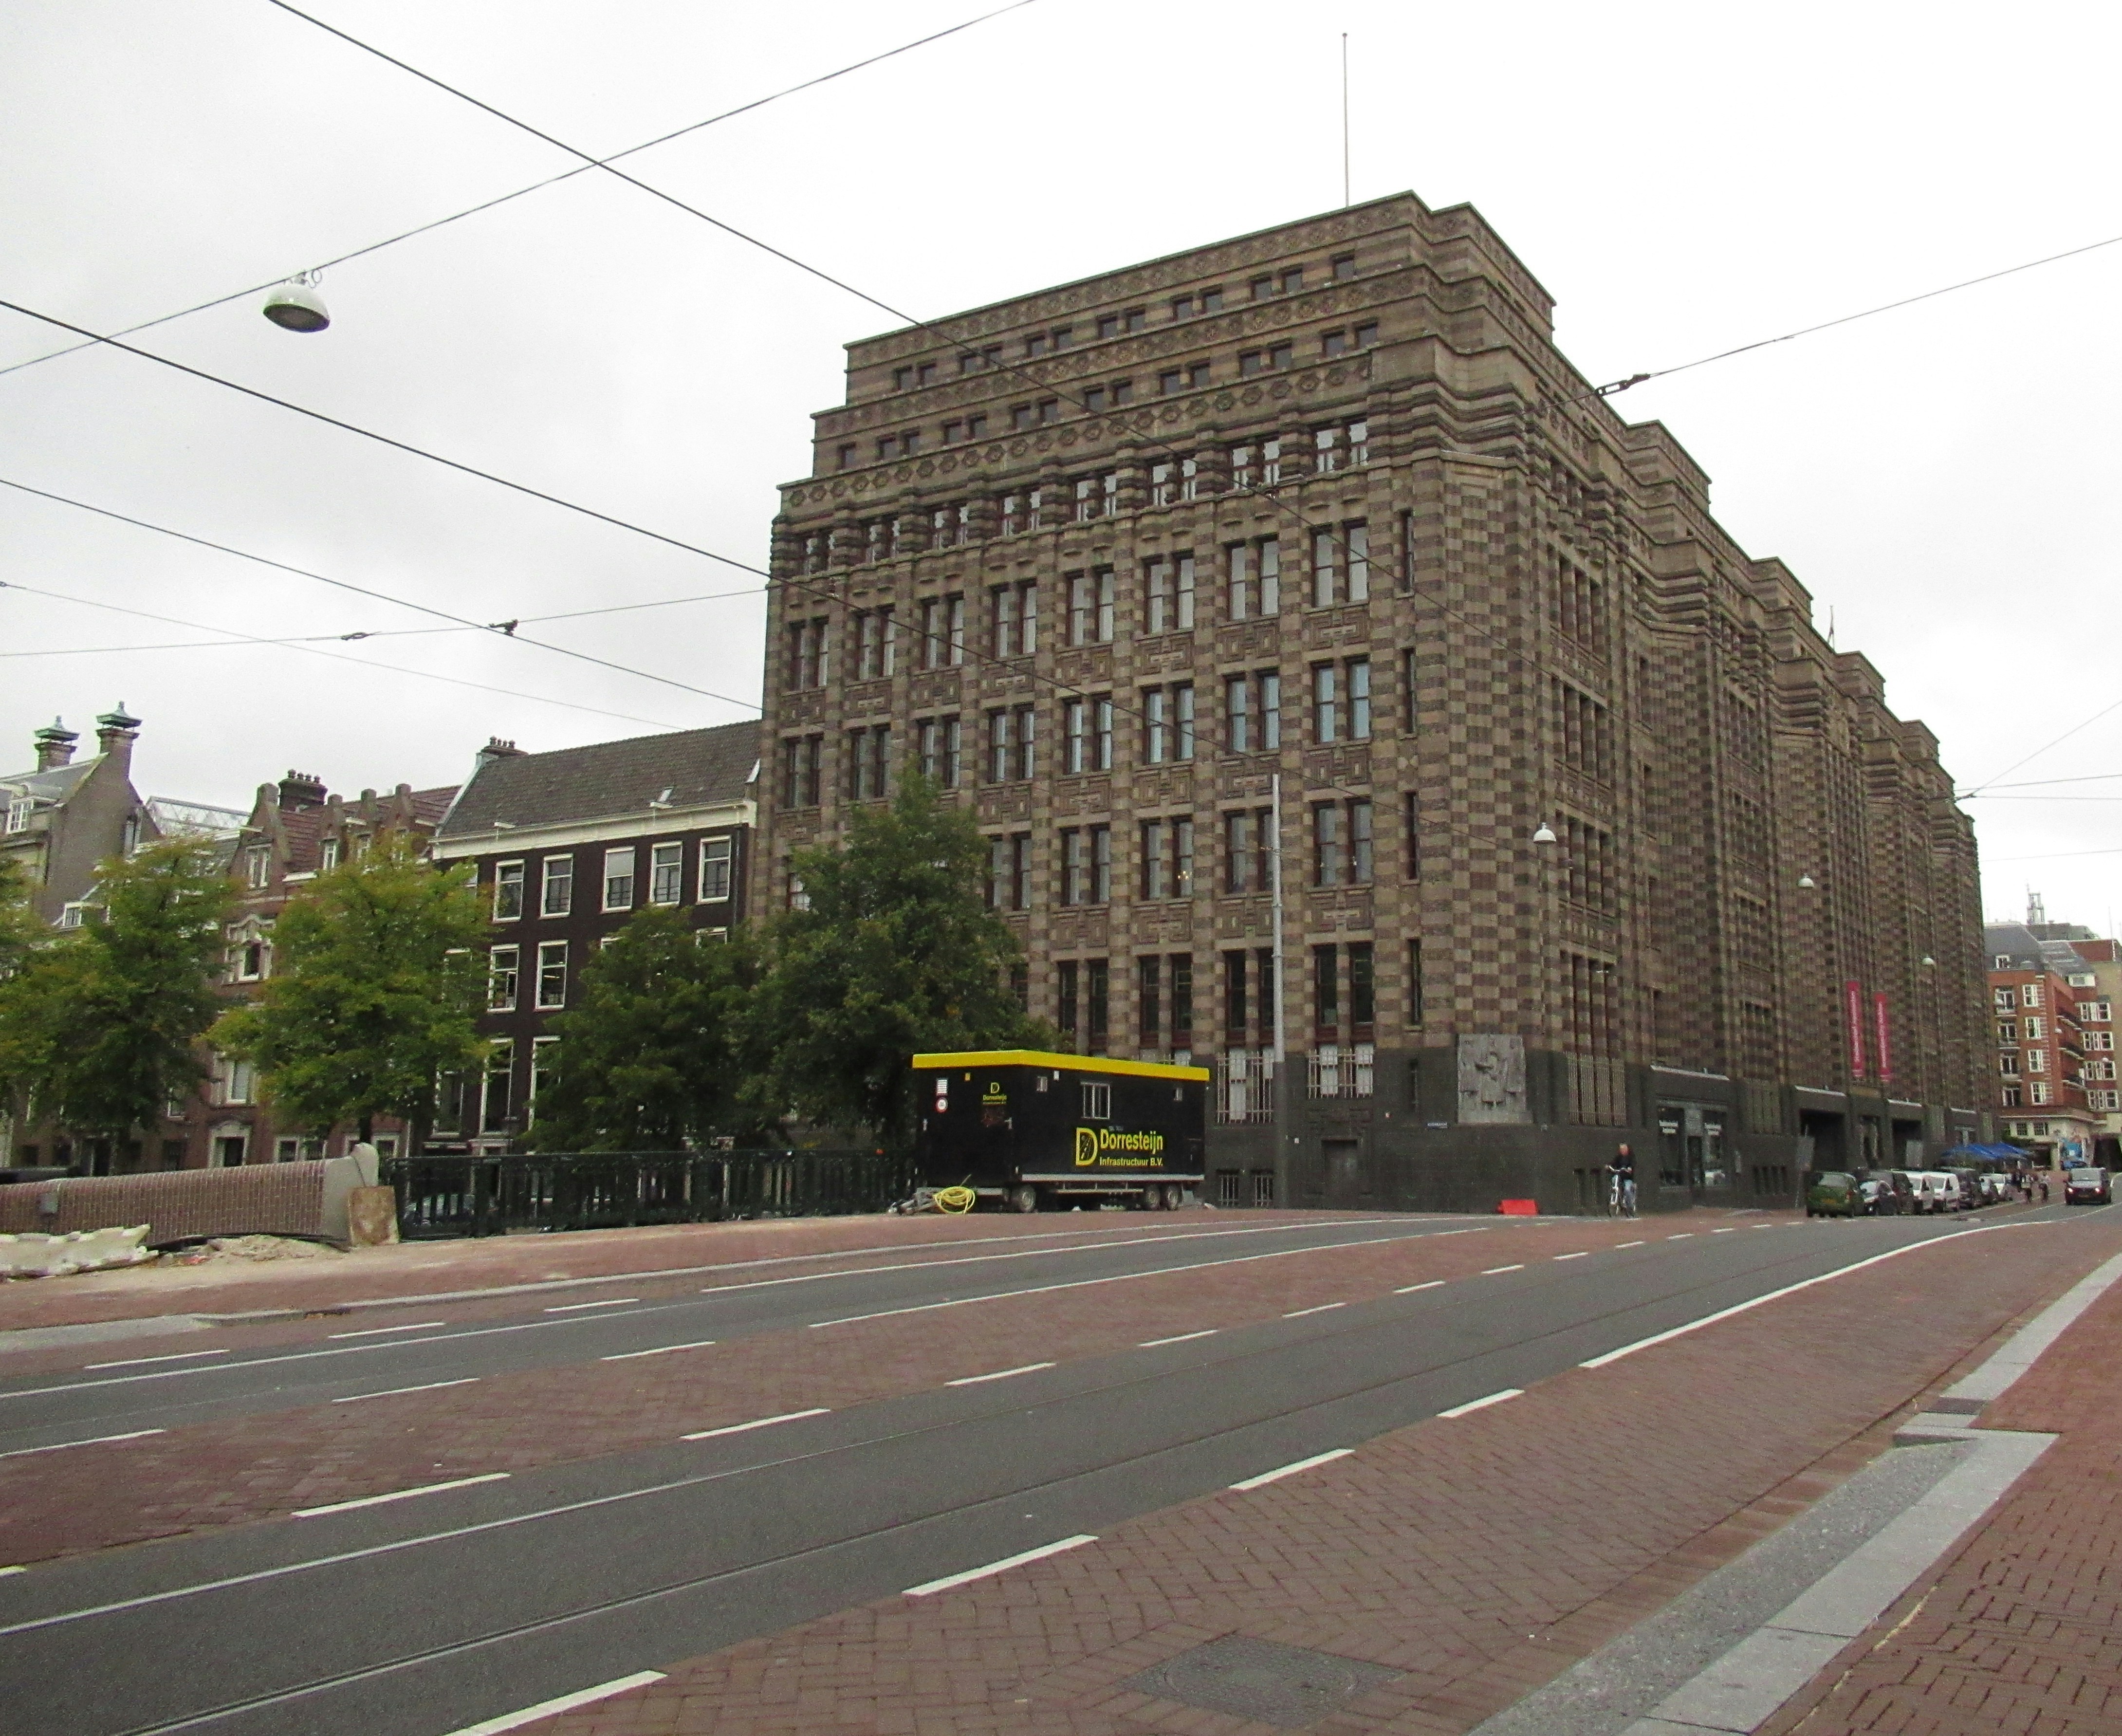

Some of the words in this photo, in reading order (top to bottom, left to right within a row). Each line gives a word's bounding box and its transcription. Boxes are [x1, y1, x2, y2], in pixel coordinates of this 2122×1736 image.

[1076, 1127, 1098, 1166] D
[1100, 1128, 1163, 1154] Dorresteijn
[1100, 1157, 1148, 1166] Infrastructuur
[1150, 1157, 1163, 1166] B.V.
